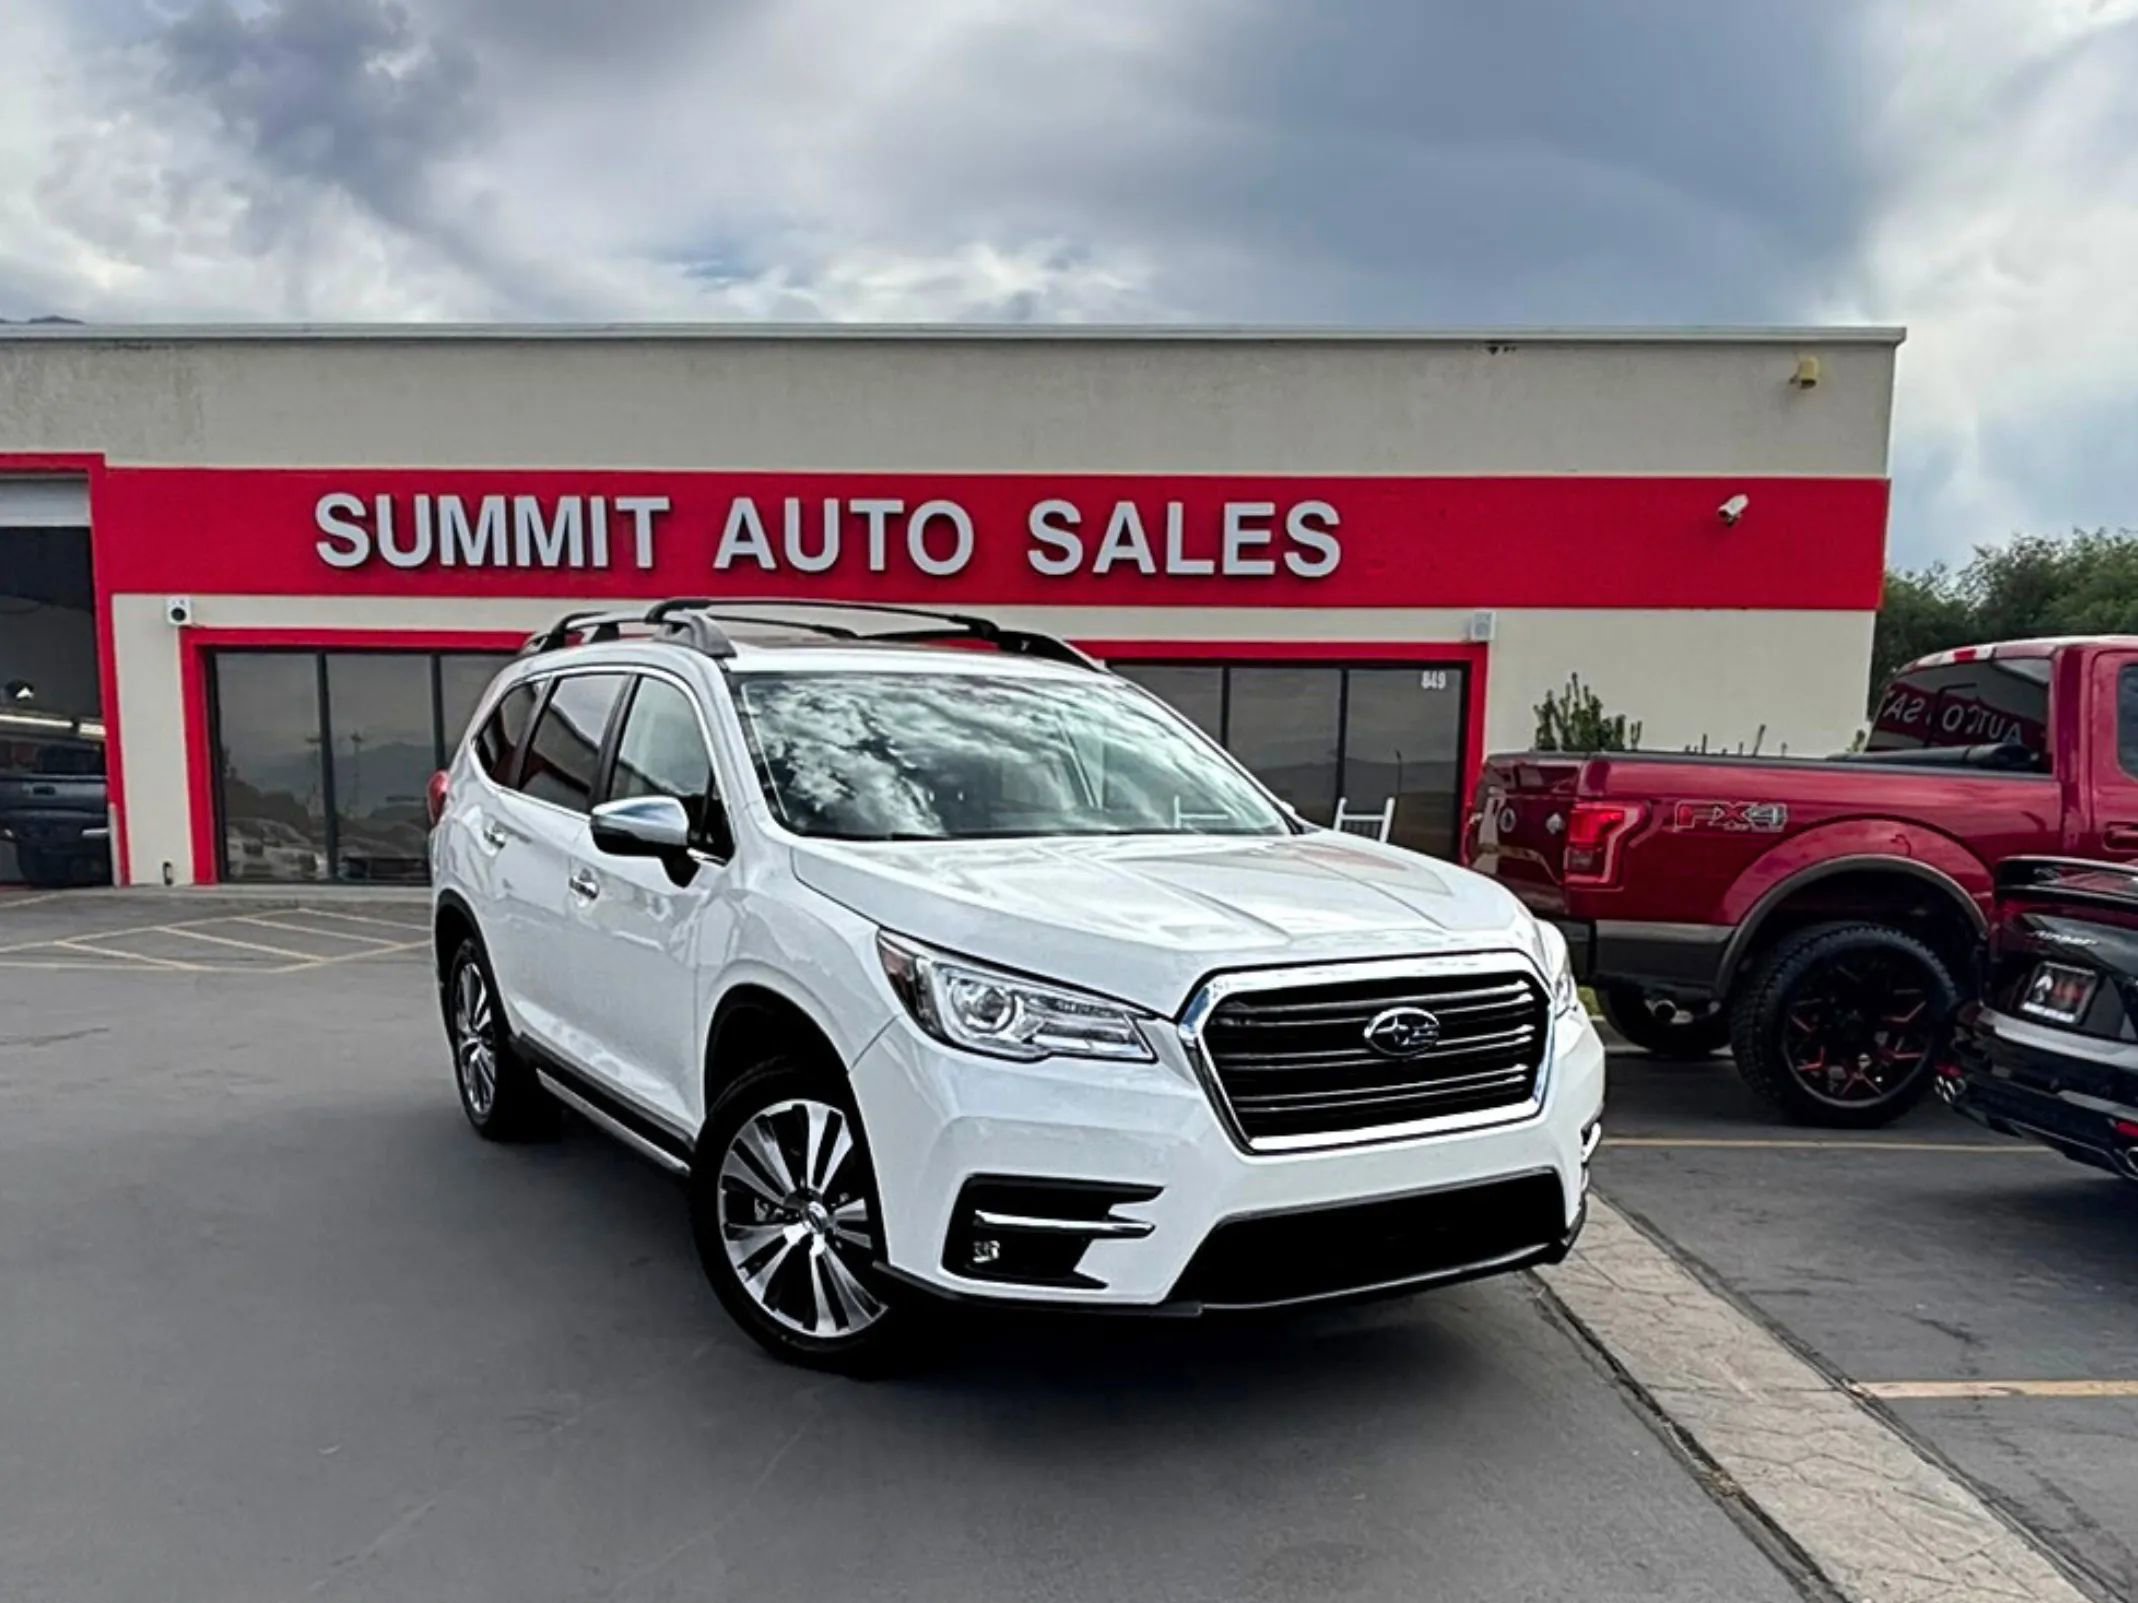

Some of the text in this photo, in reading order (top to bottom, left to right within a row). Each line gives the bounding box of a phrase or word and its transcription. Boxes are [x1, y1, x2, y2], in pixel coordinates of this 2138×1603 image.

[314, 492, 1342, 578] SUMMIT AUTO SALES
[1673, 800, 1788, 833] FX4
